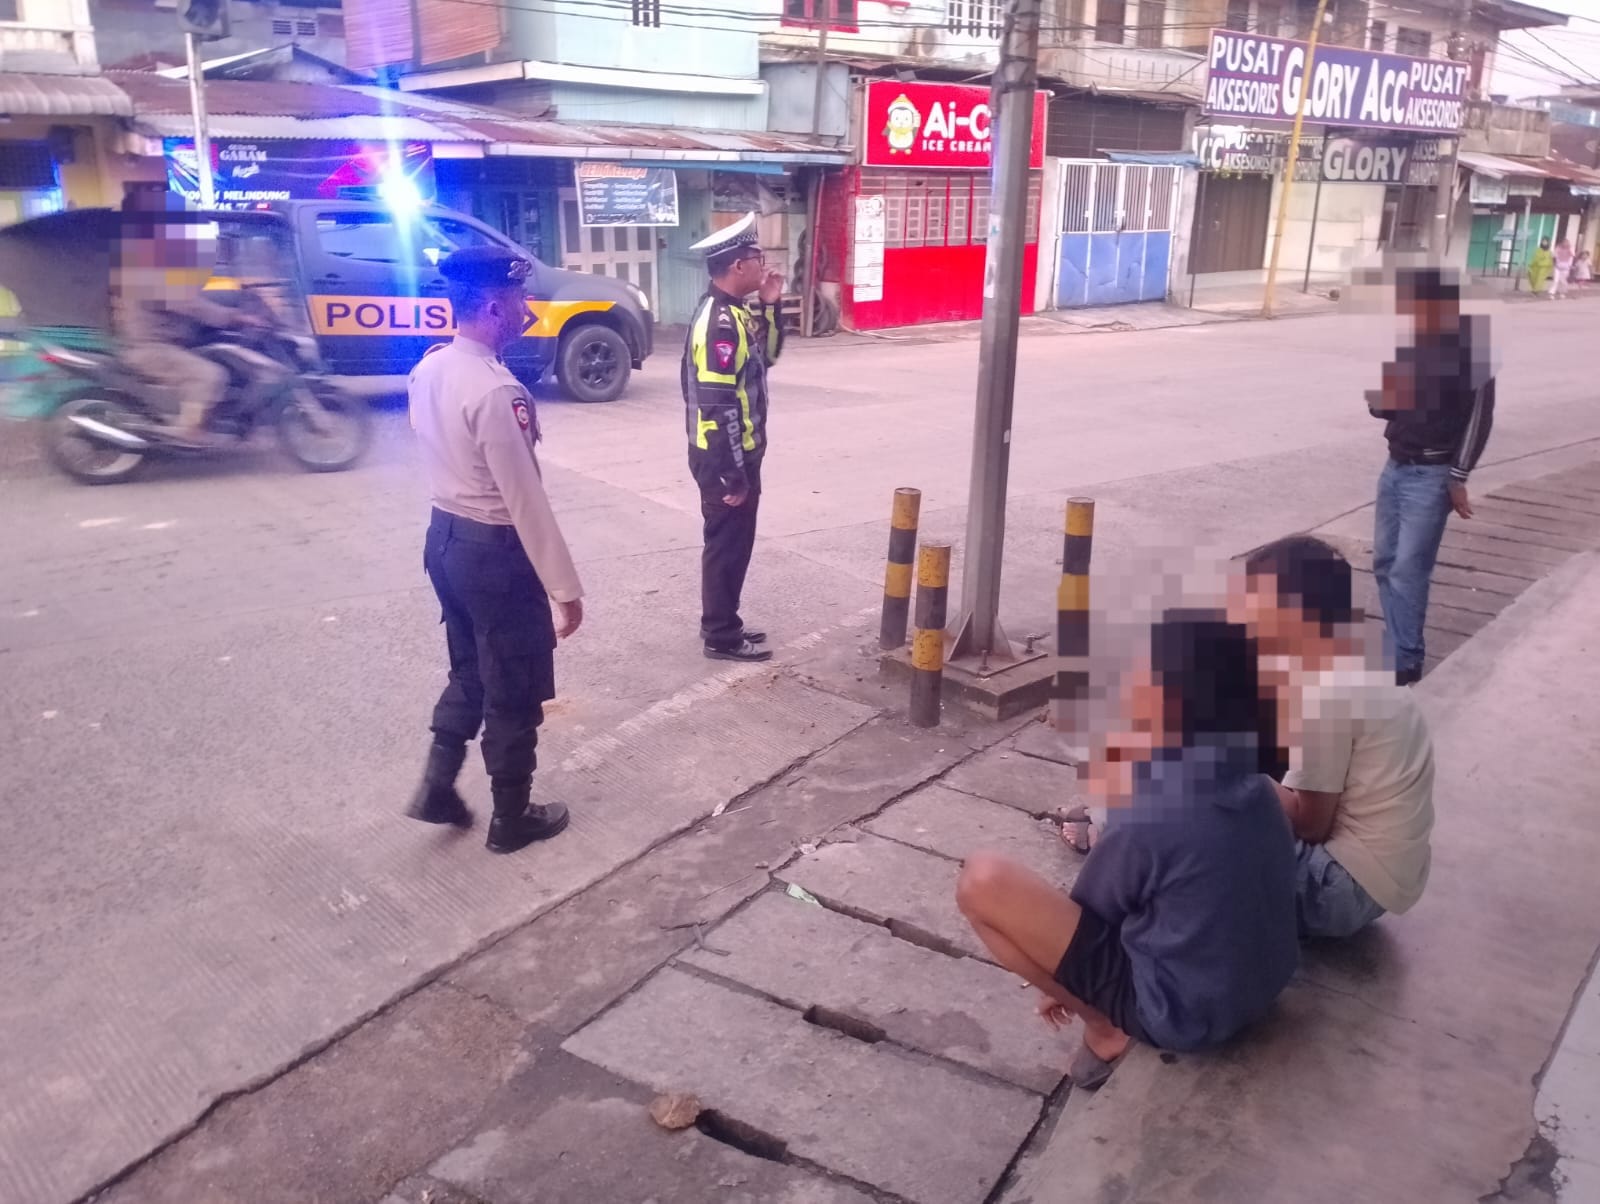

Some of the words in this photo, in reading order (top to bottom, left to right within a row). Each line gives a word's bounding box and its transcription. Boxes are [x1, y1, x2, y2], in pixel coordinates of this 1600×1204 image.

[1211, 36, 1284, 75] PUSAT
[1207, 77, 1280, 115] AKSESORIS
[1282, 47, 1360, 119] GORY
[1360, 58, 1408, 123] ACC
[1410, 62, 1465, 95] PUSAT
[923, 101, 992, 140] Ai-C
[1405, 97, 1461, 129] AKSESORIS
[220, 150, 267, 161] GARAM
[922, 140, 945, 151] ICE
[1323, 138, 1408, 181] GLORY
[223, 190, 290, 201] MELINDUNGI
